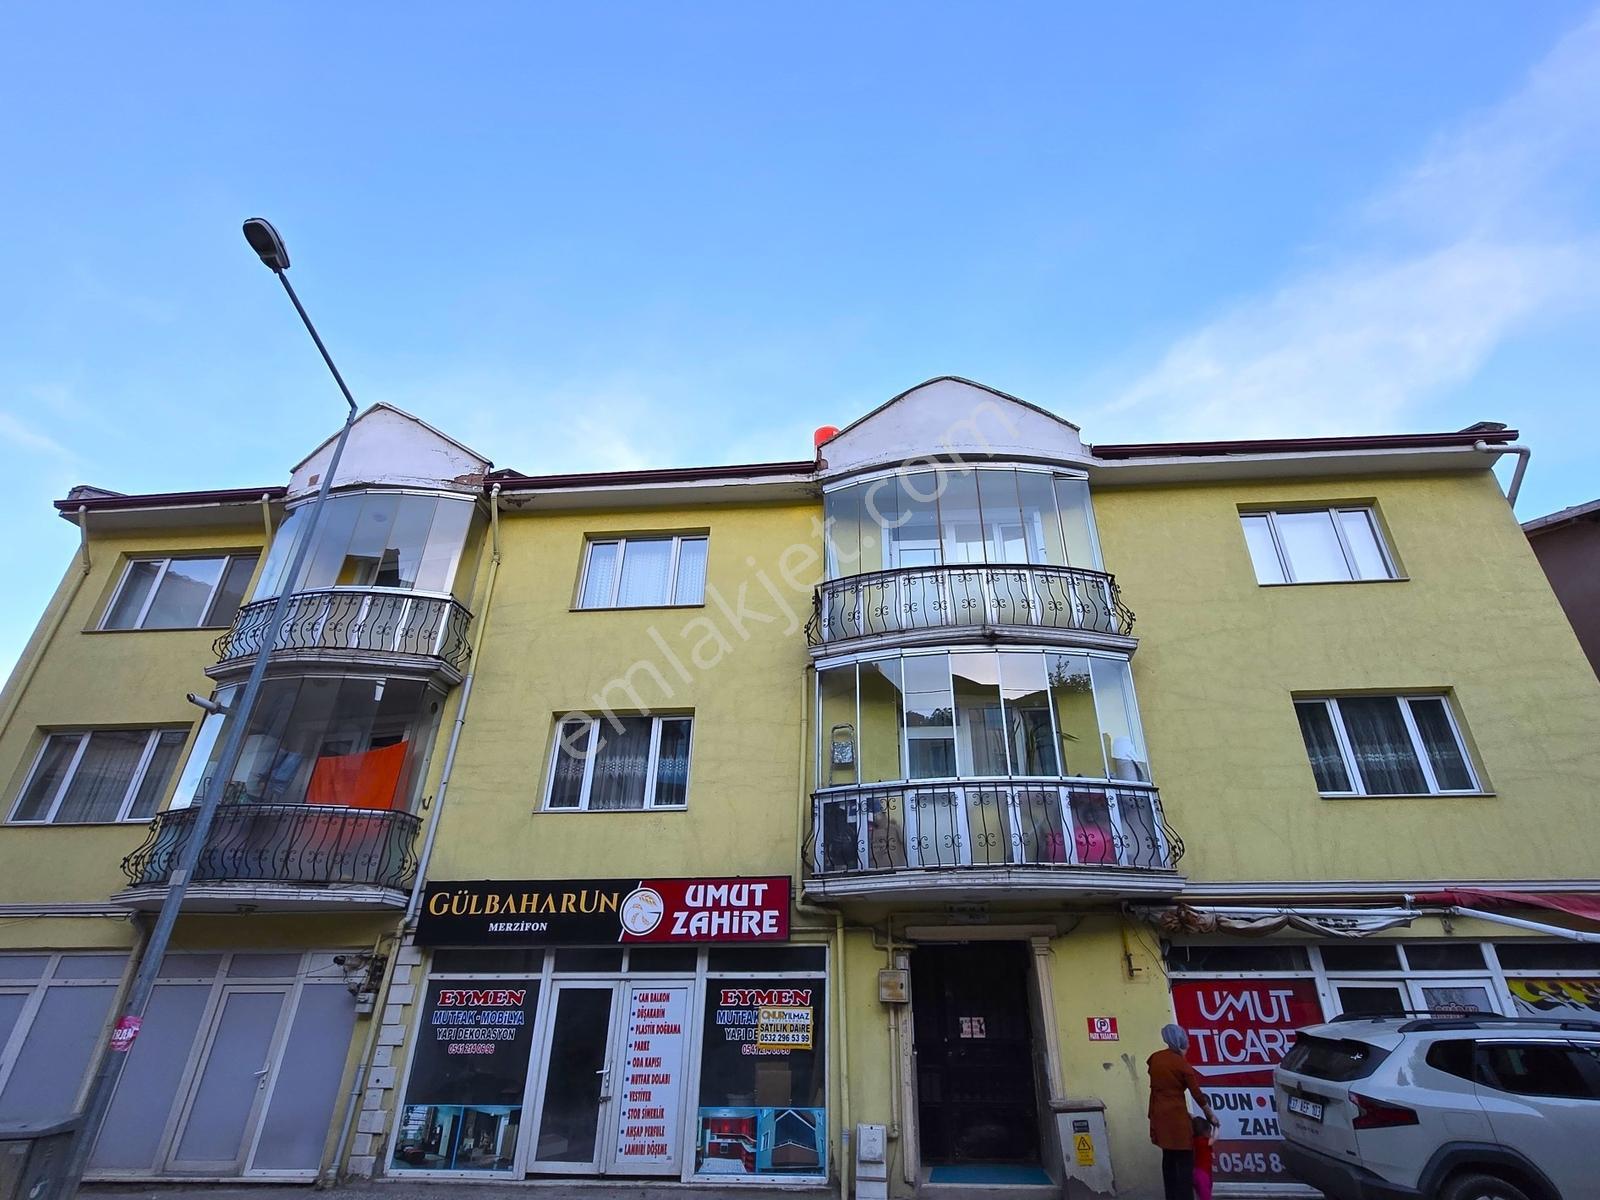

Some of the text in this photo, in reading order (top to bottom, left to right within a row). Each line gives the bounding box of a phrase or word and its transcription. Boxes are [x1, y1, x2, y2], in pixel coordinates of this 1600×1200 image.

[429, 889, 620, 916] GÜLBAHARUN
[685, 883, 768, 907] UMUT
[488, 920, 548, 932] MERZİFON
[437, 989, 526, 1006] EYMEN
[720, 989, 812, 1006] EYMEN
[1196, 990, 1293, 1023] UMUT
[436, 1027, 516, 1040] YAPI DEKORASYON
[725, 1027, 746, 1040] YAPI
[760, 1023, 788, 1033] SATILIK
[760, 1033, 777, 1042] 0532
[778, 1033, 790, 1042] 296
[791, 1034, 800, 1042] 53
[633, 1040, 650, 1051] PARKE
[632, 1057, 643, 1068] ODA
[1238, 1117, 1280, 1136] ZAH
[1219, 1152, 1267, 1173] 0545
